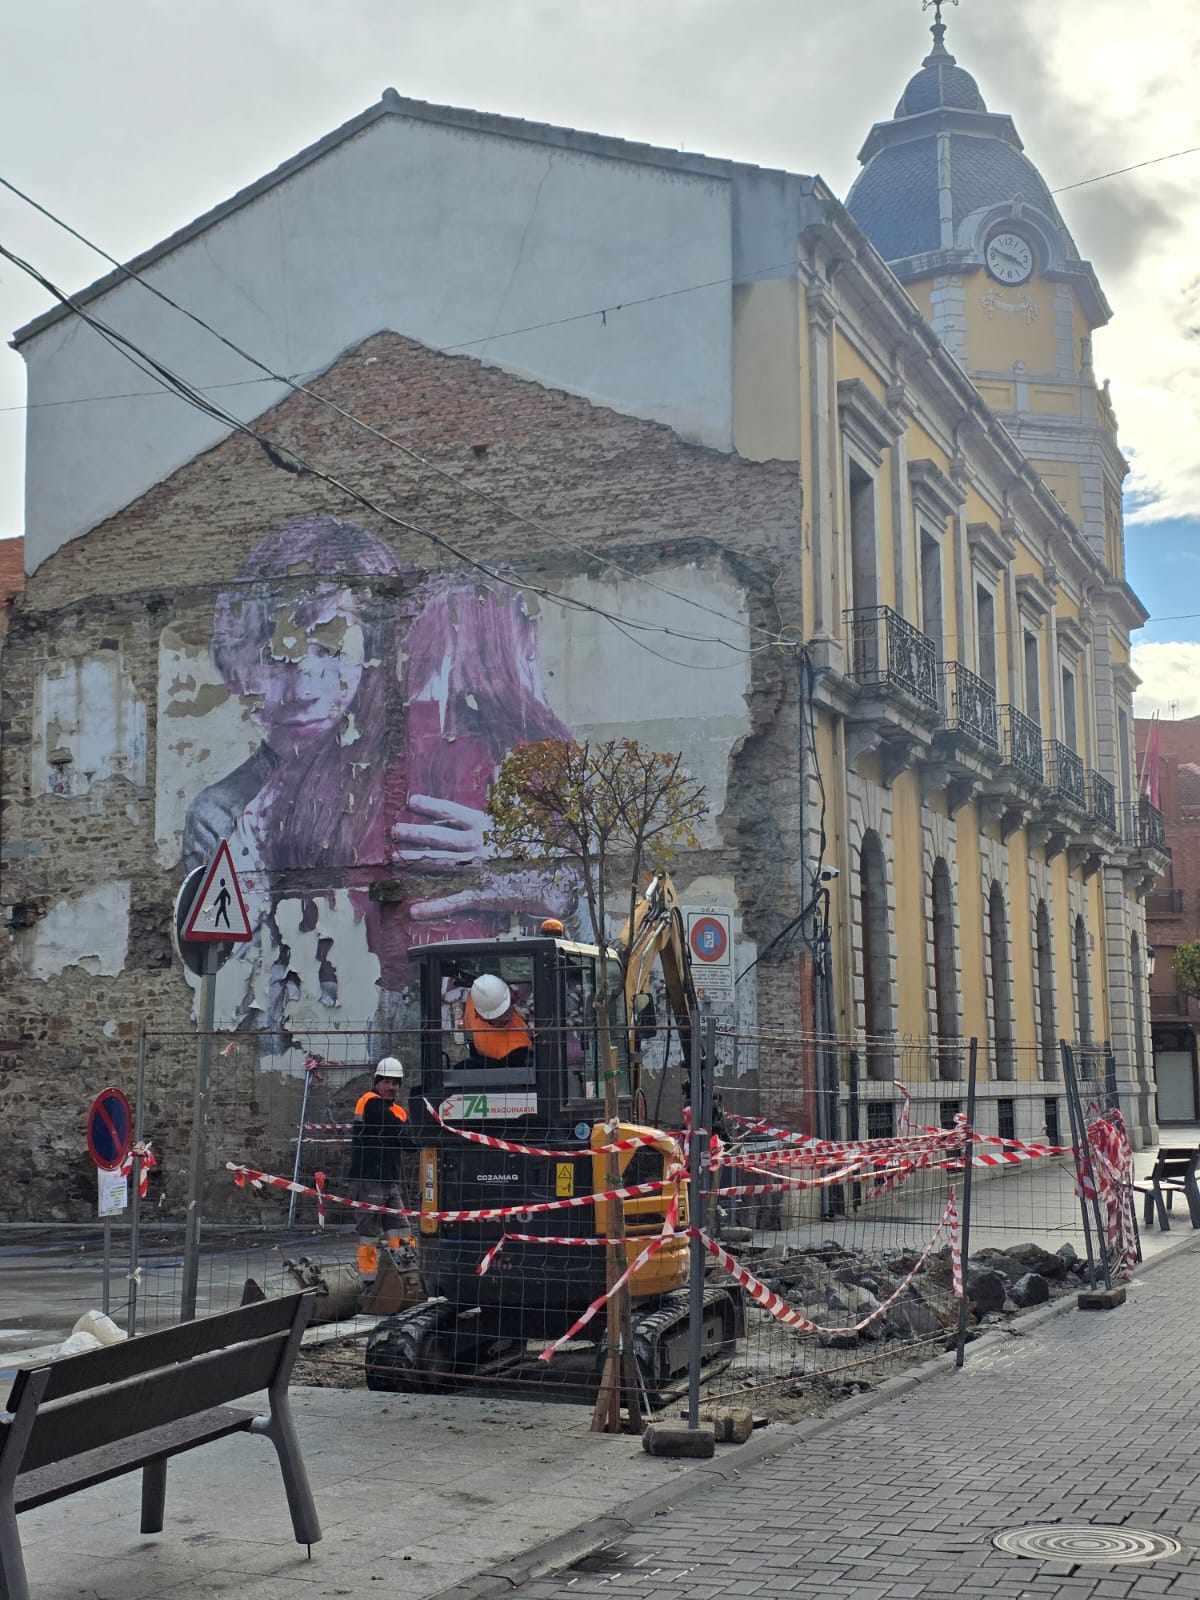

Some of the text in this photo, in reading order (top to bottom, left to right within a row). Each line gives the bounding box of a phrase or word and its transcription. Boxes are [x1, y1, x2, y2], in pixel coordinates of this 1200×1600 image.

[1005, 237, 1013, 246] 12
[1007, 270, 1013, 279] 6
[463, 1095, 535, 1118] 74 MAQUINARIA
